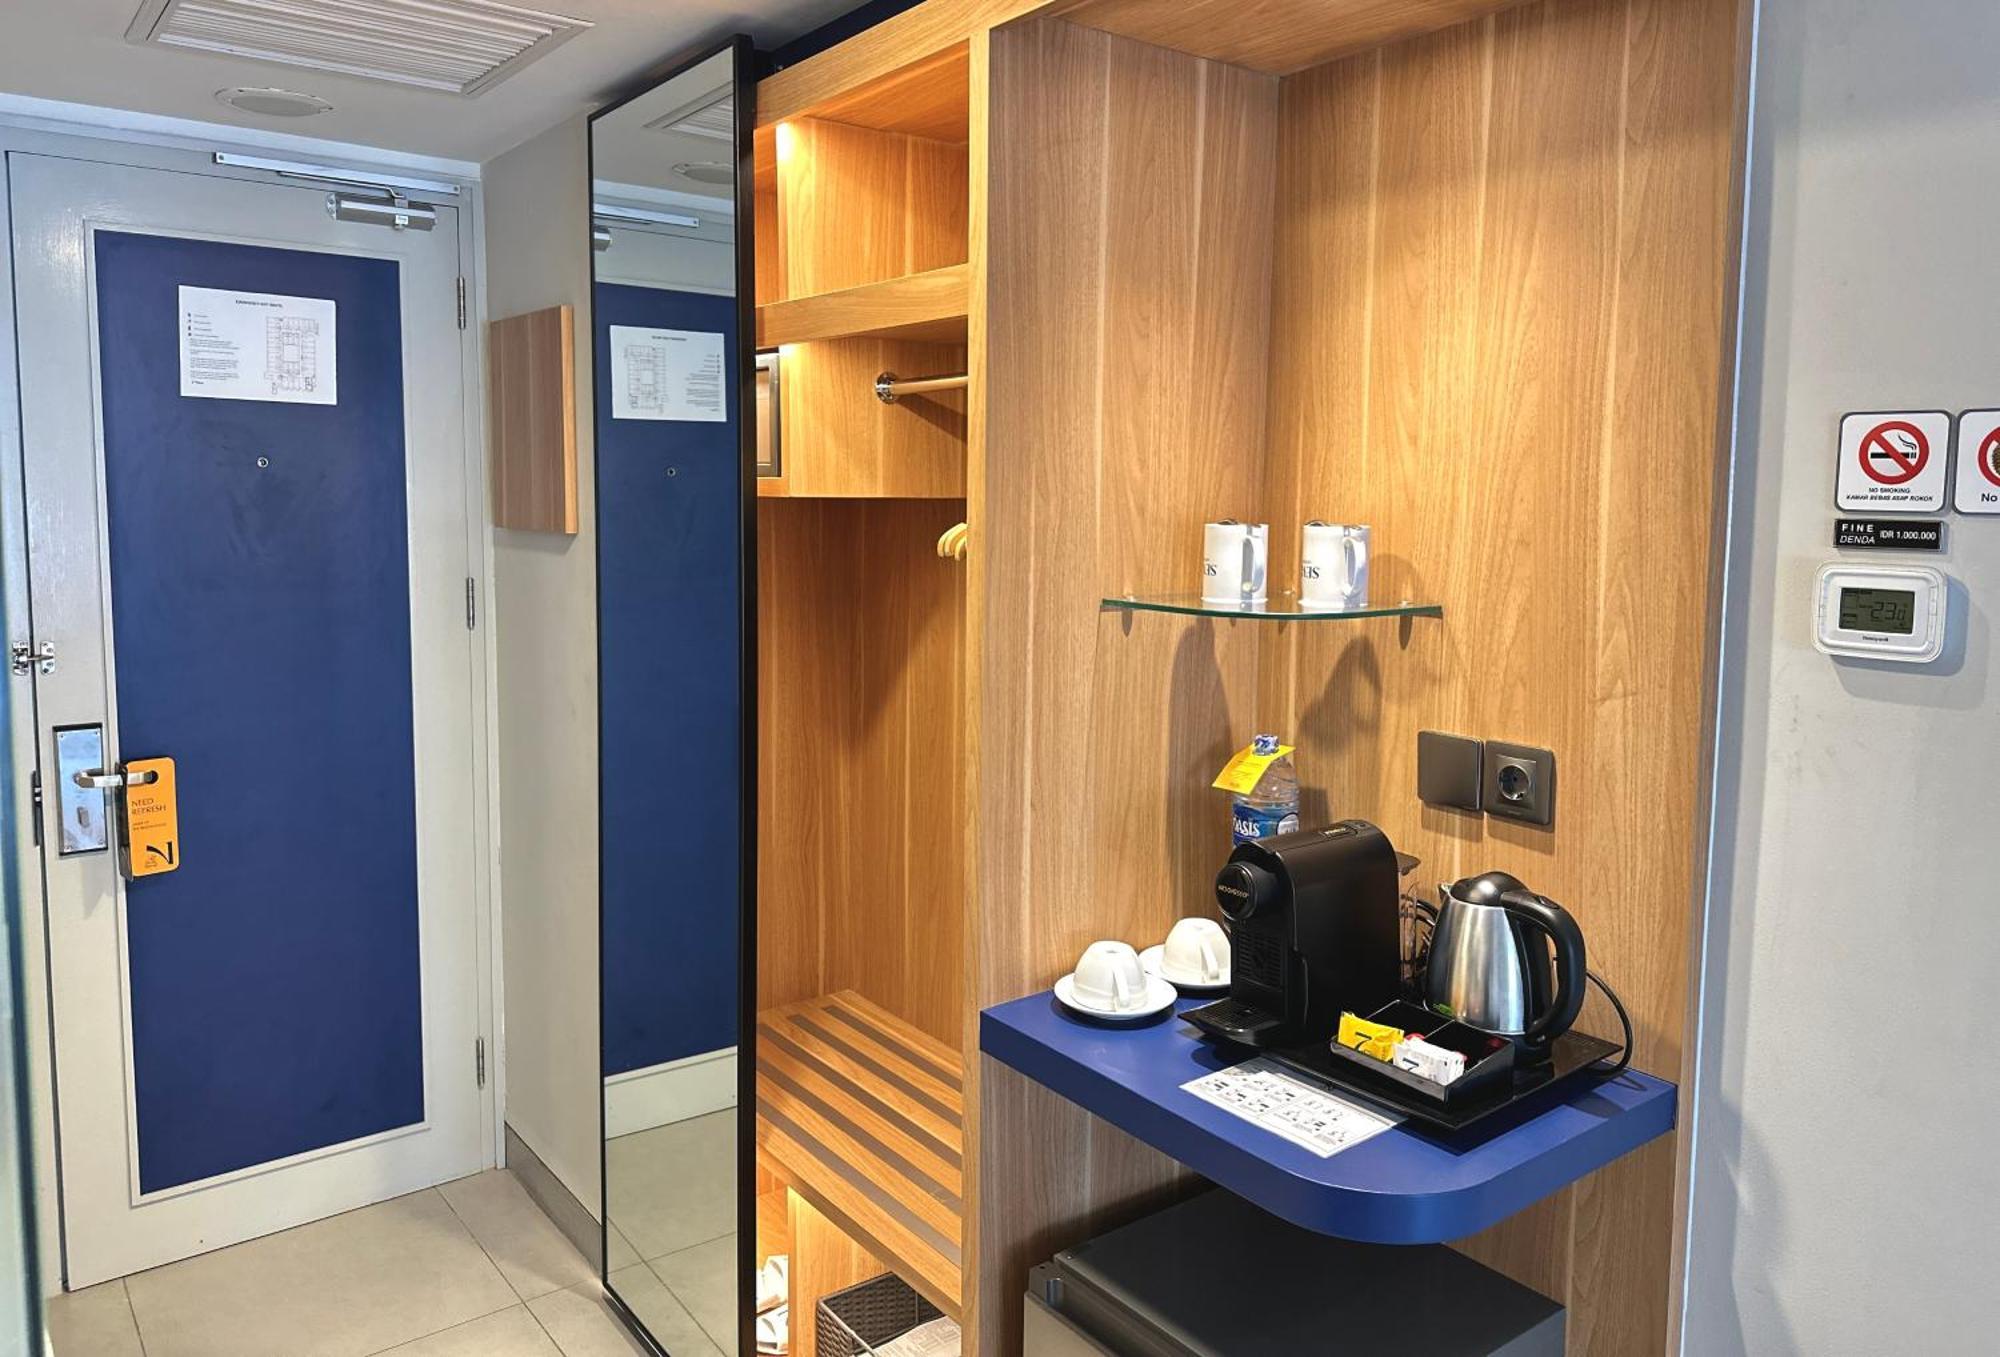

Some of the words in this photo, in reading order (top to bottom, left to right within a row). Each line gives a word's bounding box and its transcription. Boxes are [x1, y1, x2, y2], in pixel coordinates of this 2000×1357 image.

[1981, 493, 1998, 502] No
[1841, 523, 1875, 533] FINE
[1839, 535, 1875, 545] DENDA
[1880, 530, 1895, 539] IDR
[1896, 530, 1937, 540] 1.000.000
[131, 797, 154, 807] NEED
